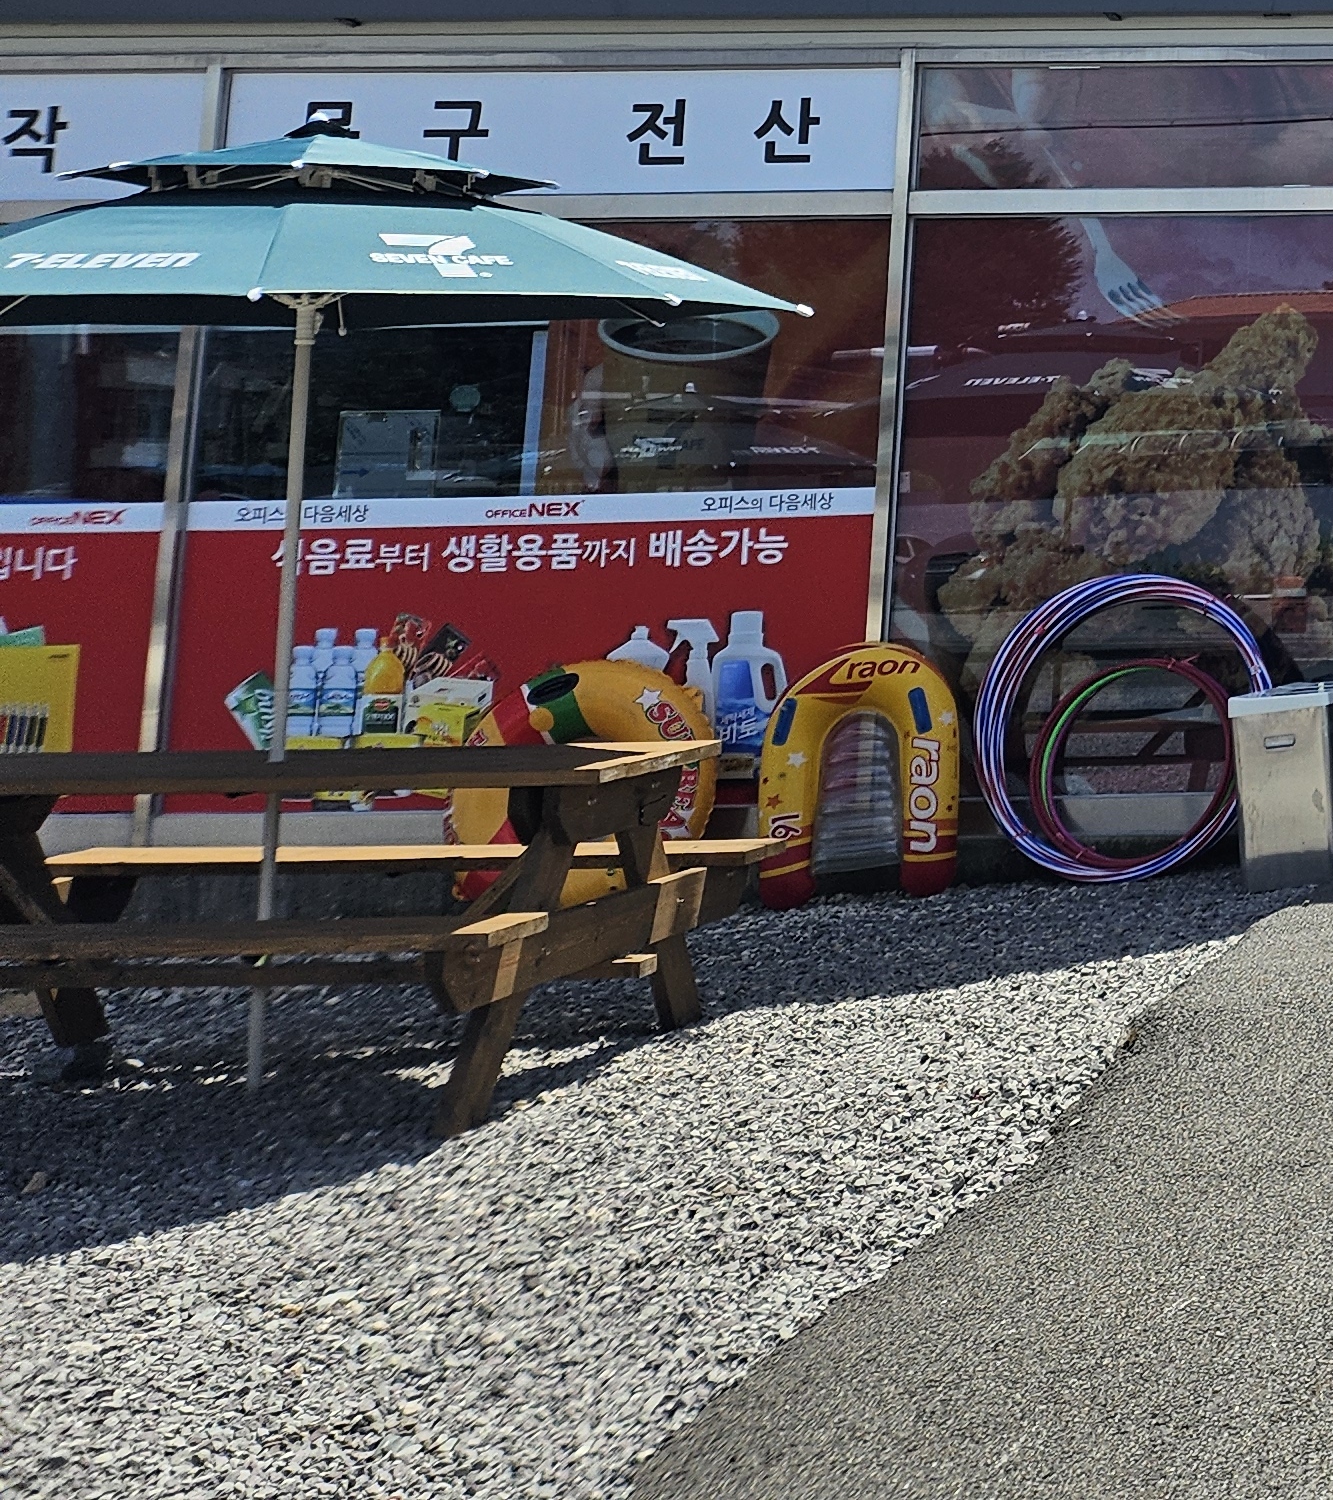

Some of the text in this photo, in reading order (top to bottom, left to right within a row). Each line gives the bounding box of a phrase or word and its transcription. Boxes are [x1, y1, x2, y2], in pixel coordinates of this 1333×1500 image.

[303, 503, 370, 524] 다음세상
[700, 491, 835, 514] 오피스의 다음세상
[441, 531, 636, 574] 생활용품까지
[648, 526, 789, 568] 배송가능
[846, 659, 921, 680] raon
[908, 736, 941, 853] raon
